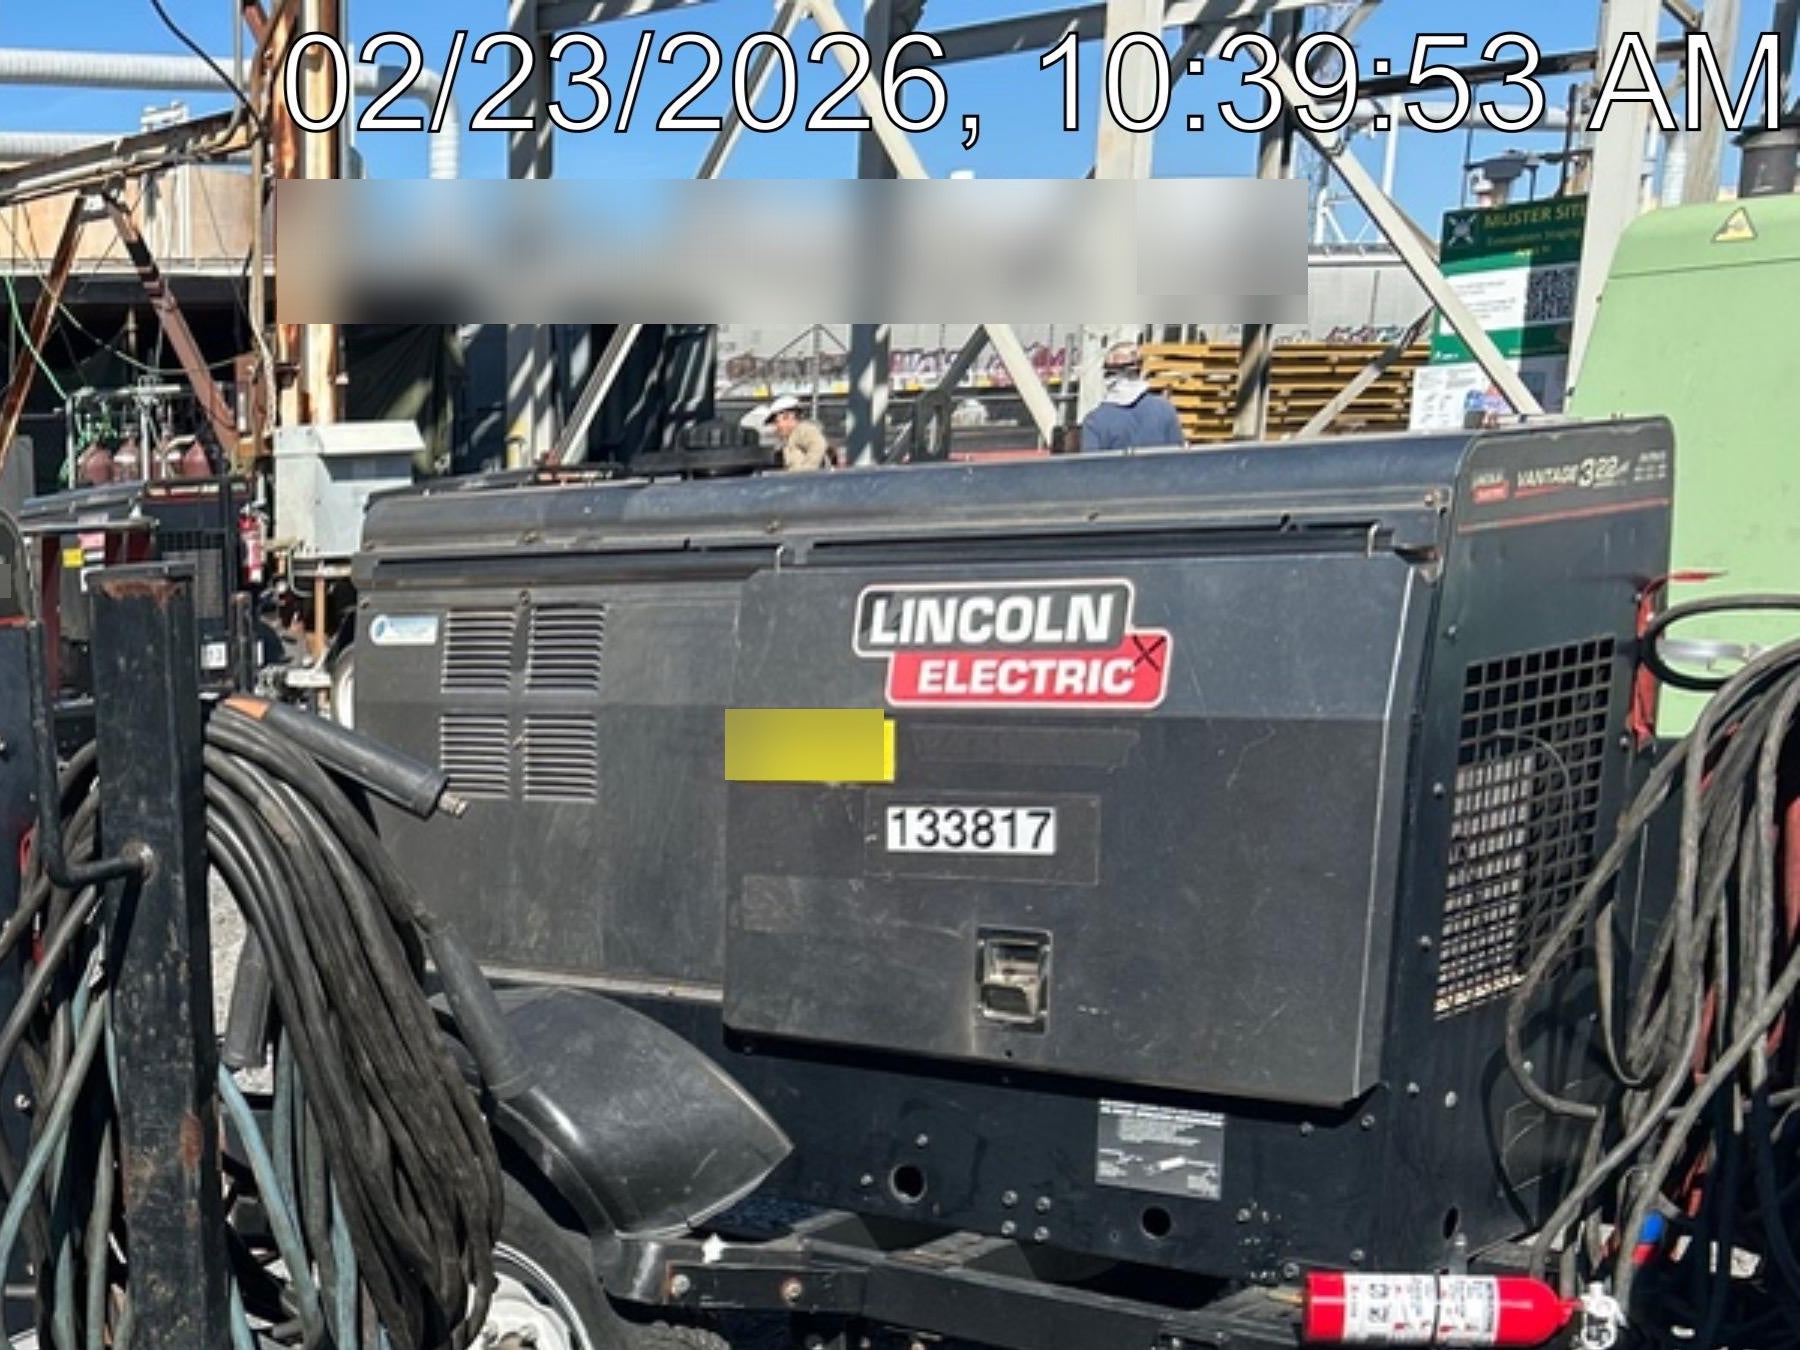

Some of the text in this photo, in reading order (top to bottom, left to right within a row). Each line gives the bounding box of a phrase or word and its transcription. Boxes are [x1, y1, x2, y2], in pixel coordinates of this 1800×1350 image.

[869, 593, 1115, 645] LINCOLN
[917, 658, 1136, 696] ELECTRIC
[890, 808, 1052, 849] 133817
